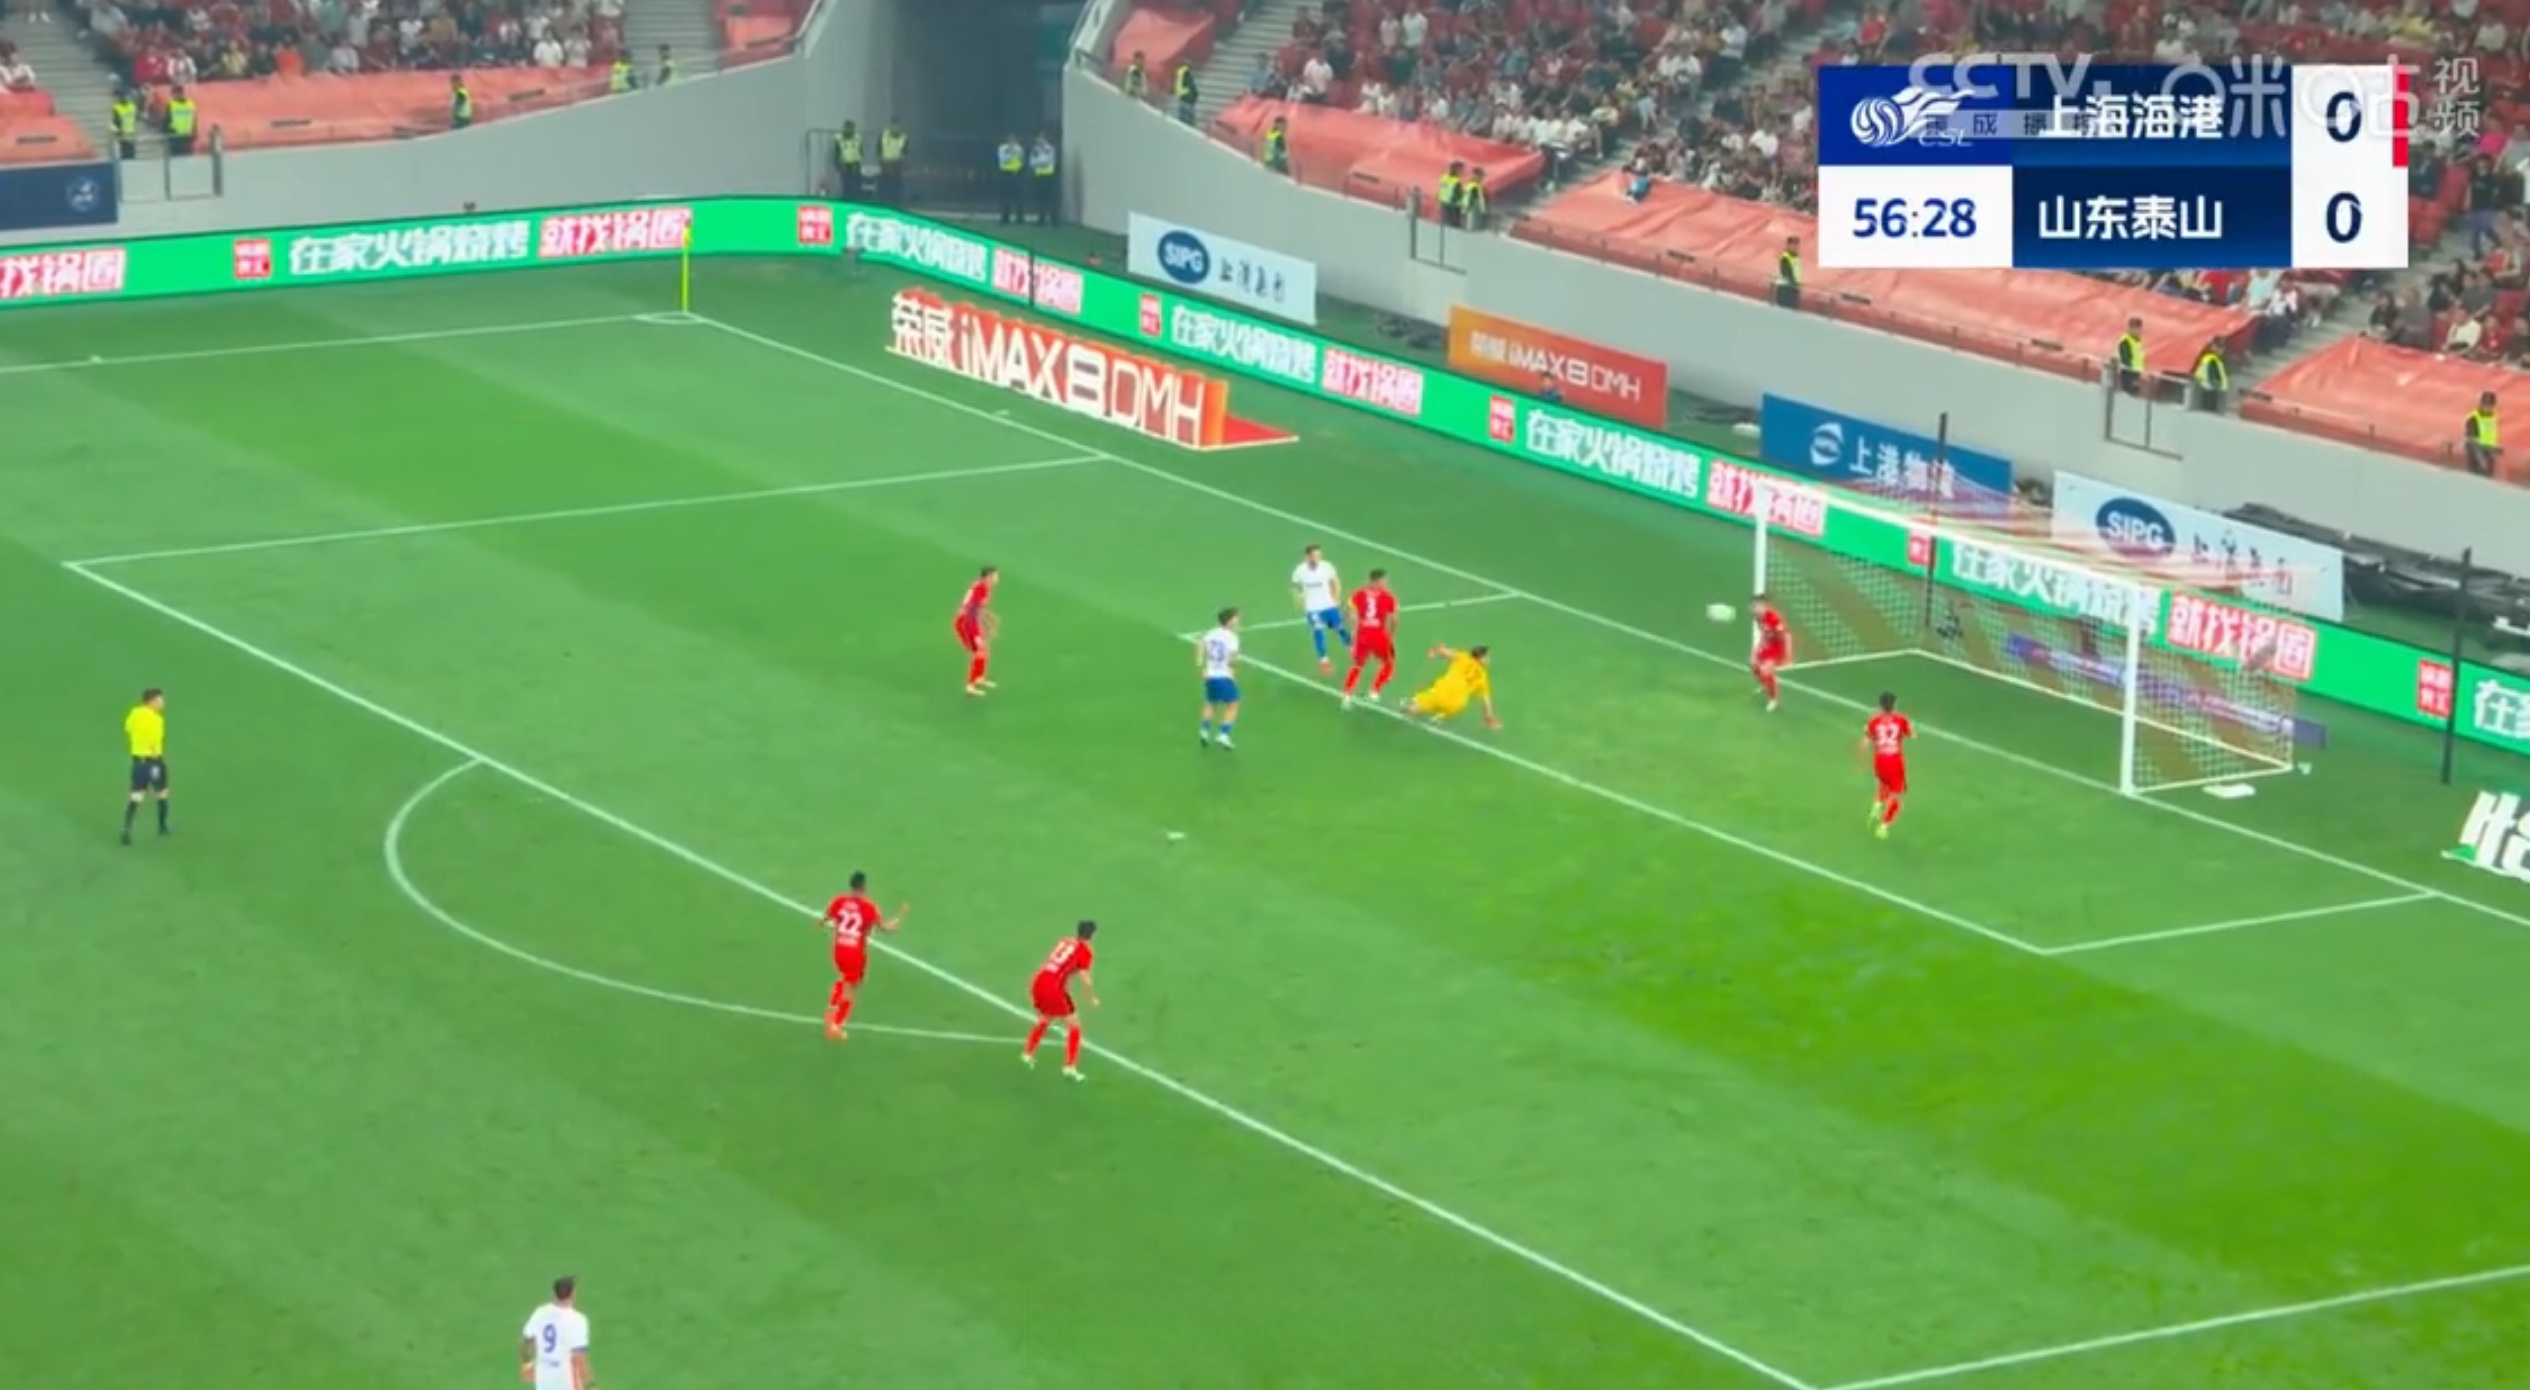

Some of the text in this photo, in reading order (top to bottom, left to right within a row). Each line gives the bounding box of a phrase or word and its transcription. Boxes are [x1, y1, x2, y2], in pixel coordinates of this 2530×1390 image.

[1164, 241, 1204, 273] SIPG
[2107, 511, 2164, 550] SIPG
[837, 910, 862, 936] 22
[543, 1323, 556, 1353] 9
